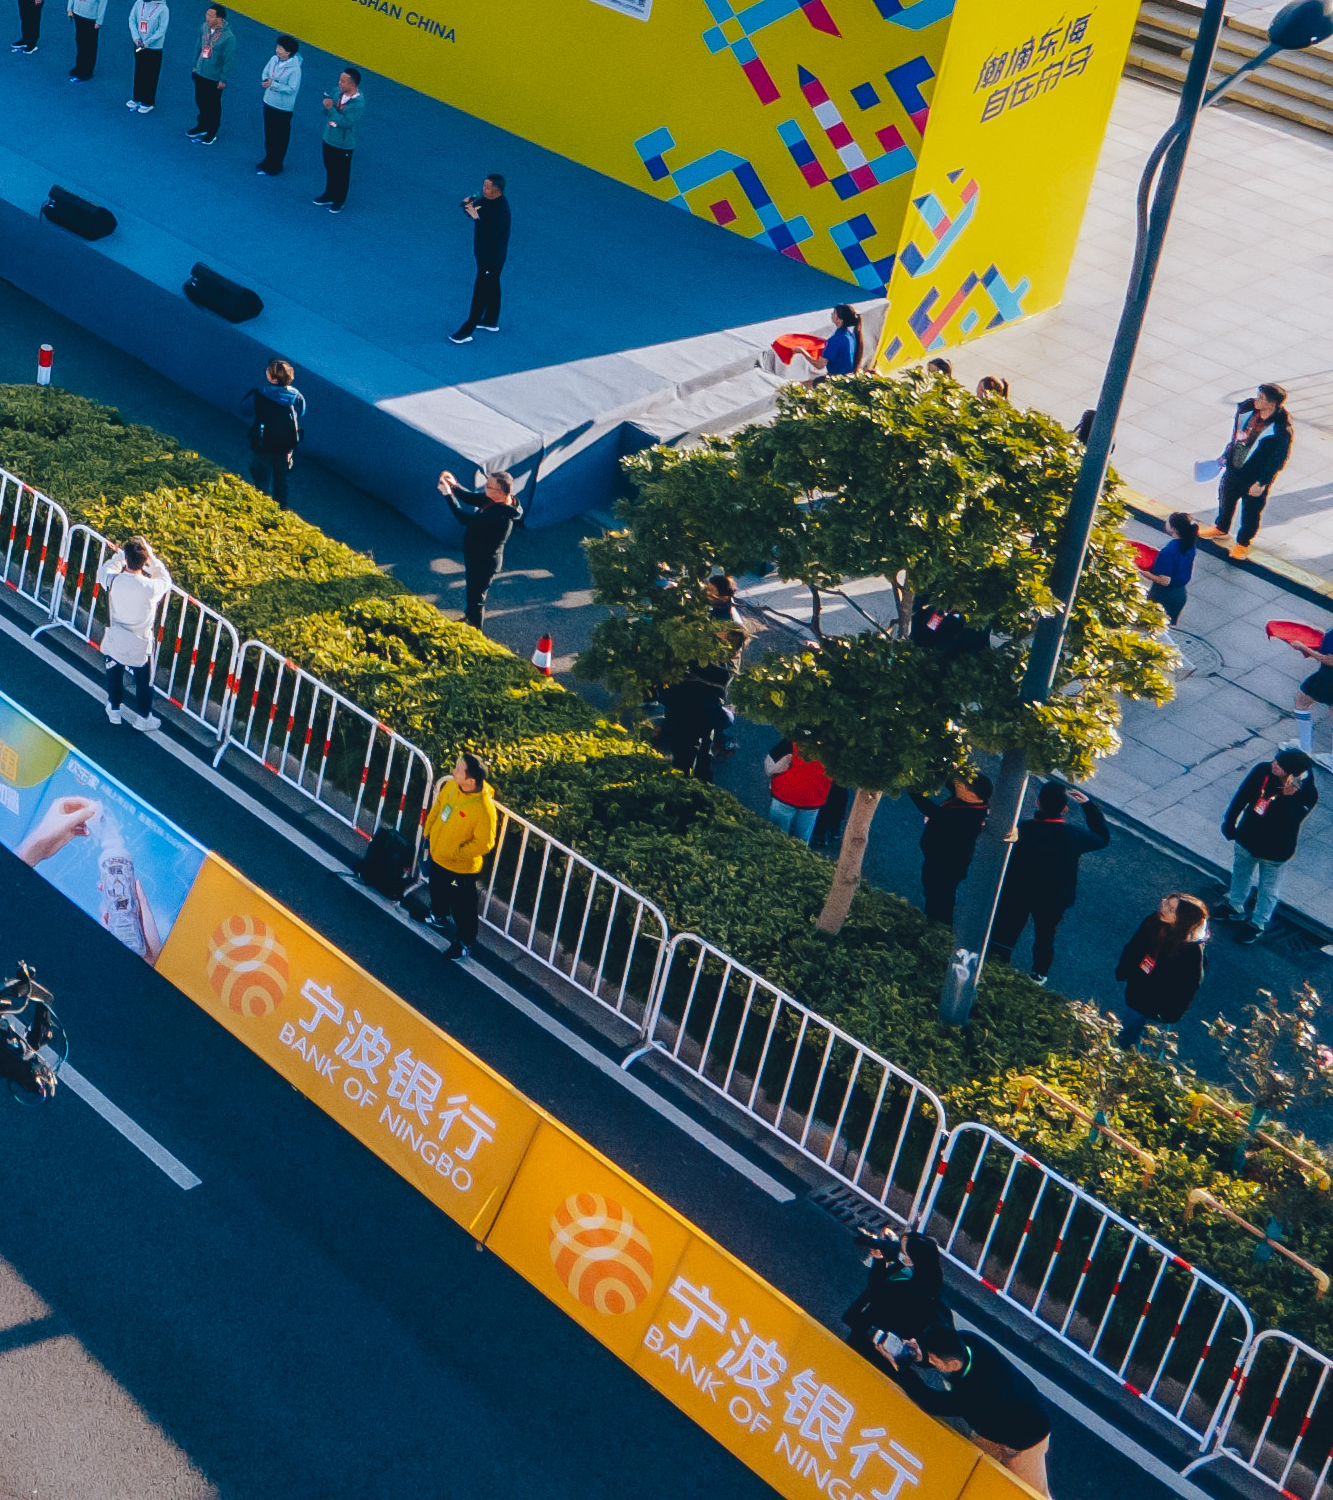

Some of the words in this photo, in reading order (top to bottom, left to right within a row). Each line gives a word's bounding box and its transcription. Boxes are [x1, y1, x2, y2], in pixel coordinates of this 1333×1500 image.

[406, 12, 456, 43] CHINA
[279, 1022, 341, 1084] BANK
[343, 1076, 378, 1108] OF
[379, 1104, 473, 1192] NINGBO
[300, 978, 496, 1161] 宁波银行
[644, 1324, 724, 1403] BANK
[728, 1396, 773, 1434] OF
[668, 1275, 924, 1500] 宁波银行
